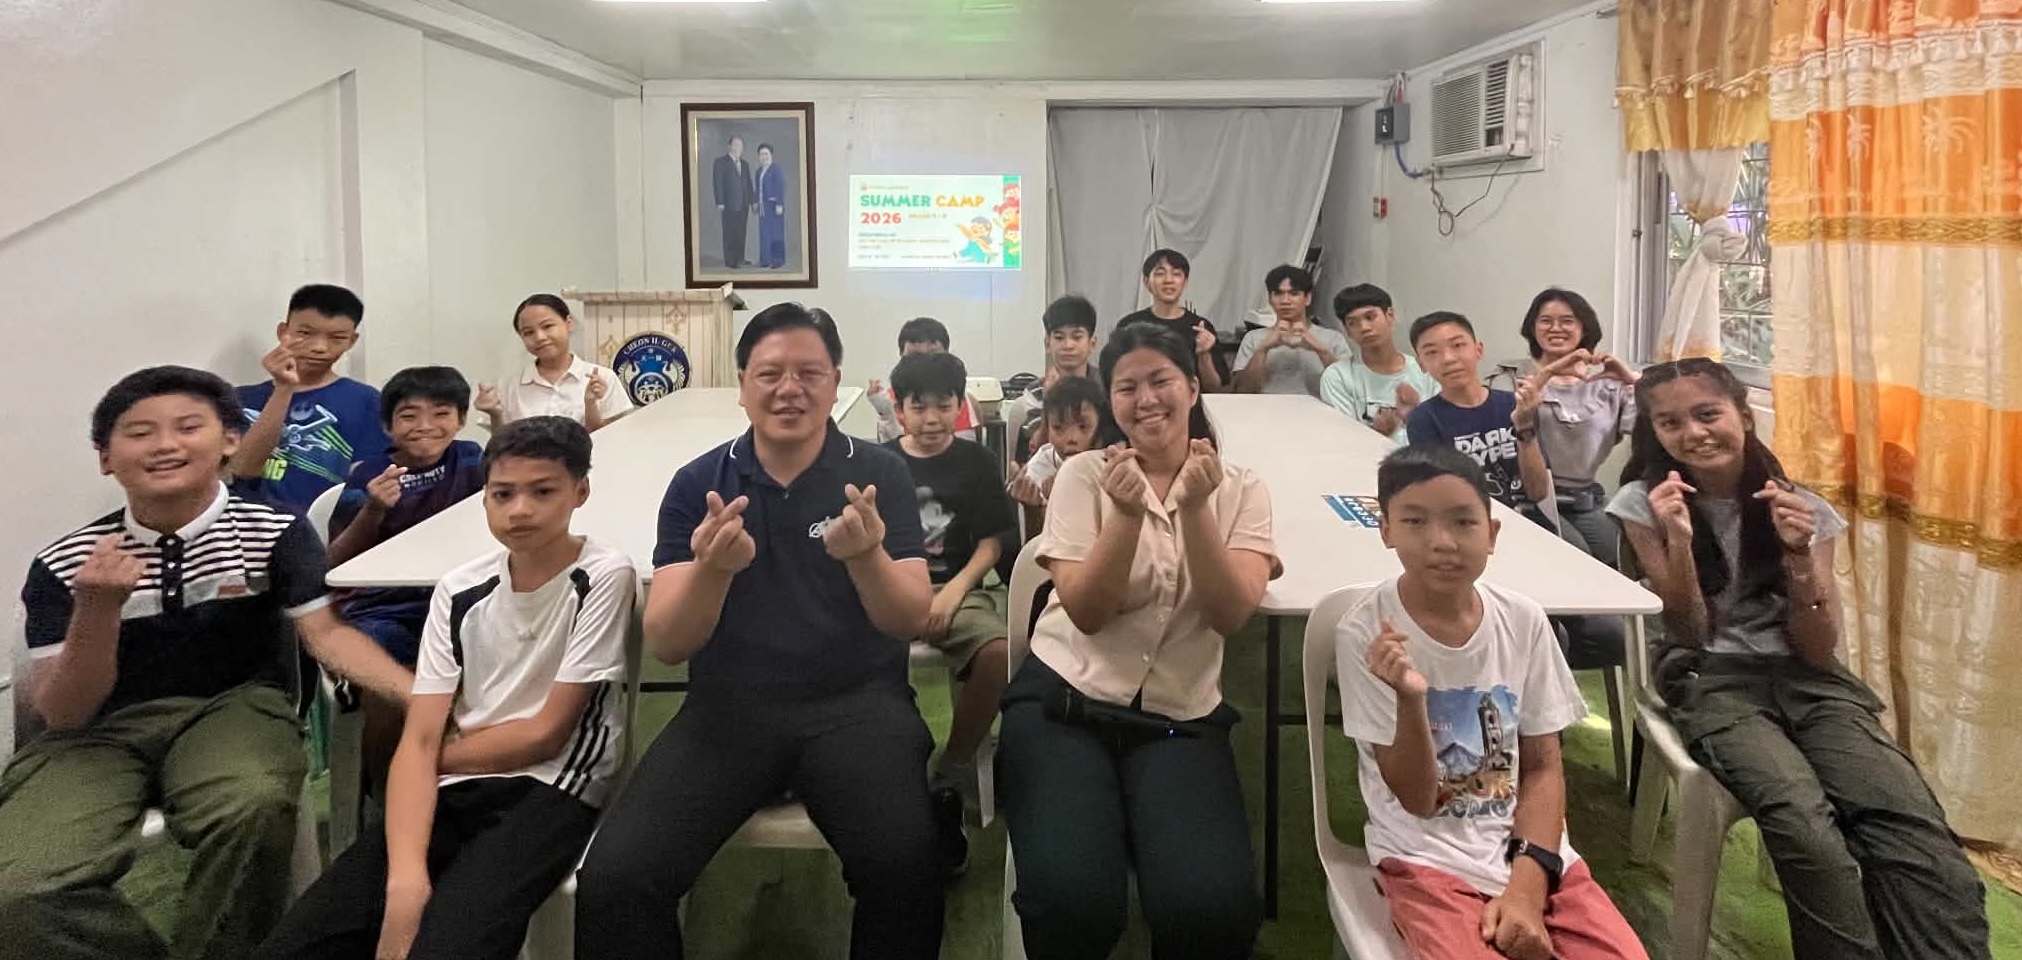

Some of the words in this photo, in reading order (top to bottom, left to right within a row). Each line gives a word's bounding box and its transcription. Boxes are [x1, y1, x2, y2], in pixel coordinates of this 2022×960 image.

[860, 194, 931, 207] SUMMER
[935, 195, 985, 207] CAMP
[860, 212, 902, 225] 2026
[1453, 427, 1518, 454] DARK
[1468, 442, 1518, 467] YPE
